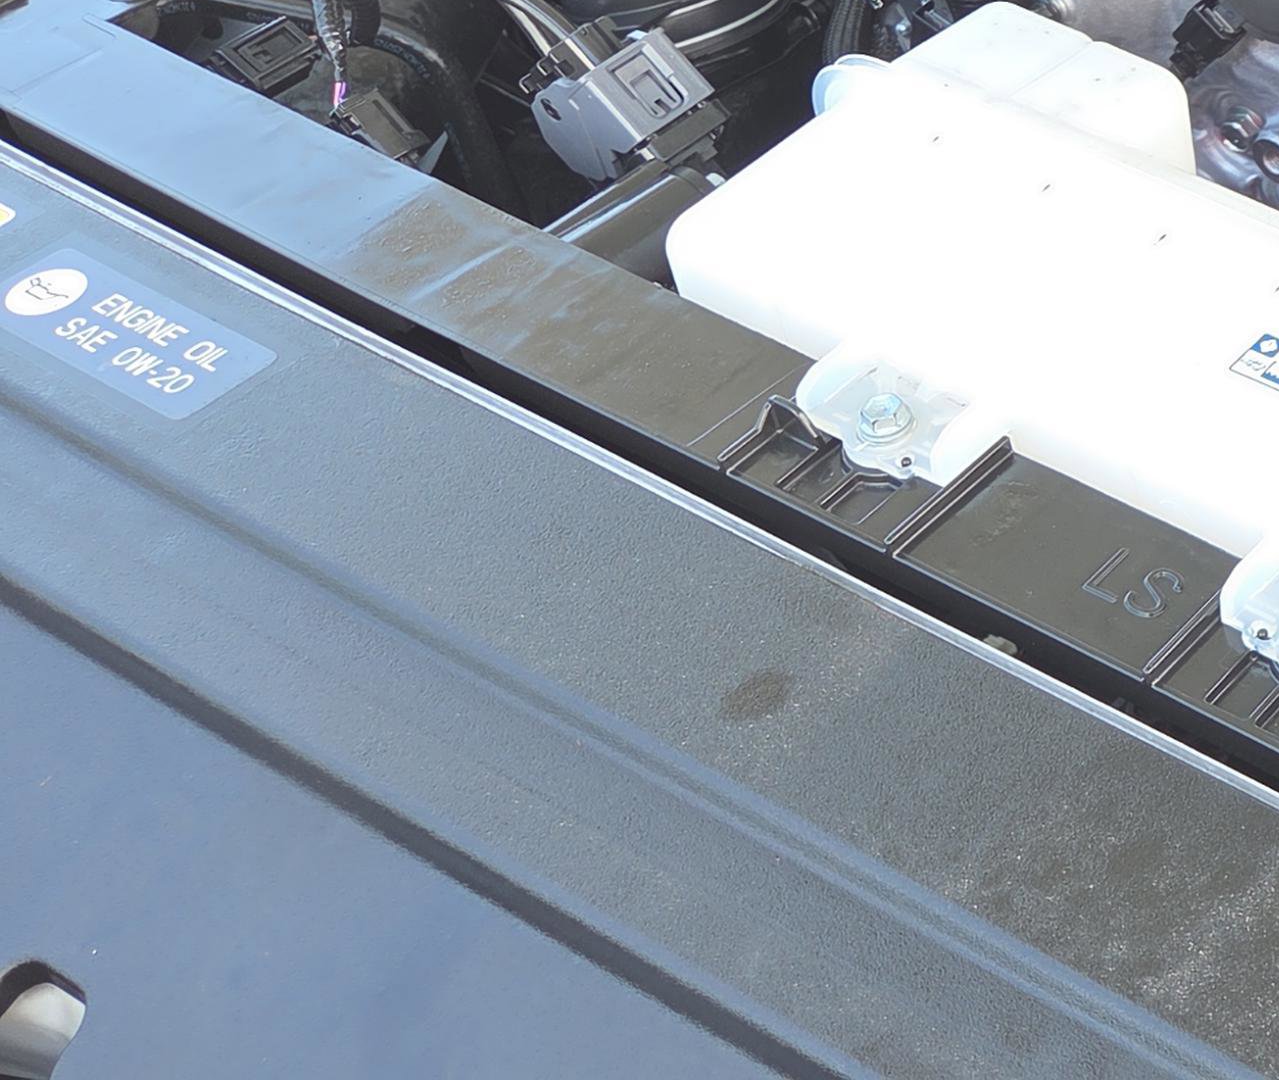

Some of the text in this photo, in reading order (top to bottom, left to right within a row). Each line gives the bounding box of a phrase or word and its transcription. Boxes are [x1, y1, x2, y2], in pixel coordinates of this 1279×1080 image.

[54, 317, 196, 394] SAE 0W-20
[91, 293, 228, 371] ENGINE OIL
[1081, 546, 1185, 619] LS
